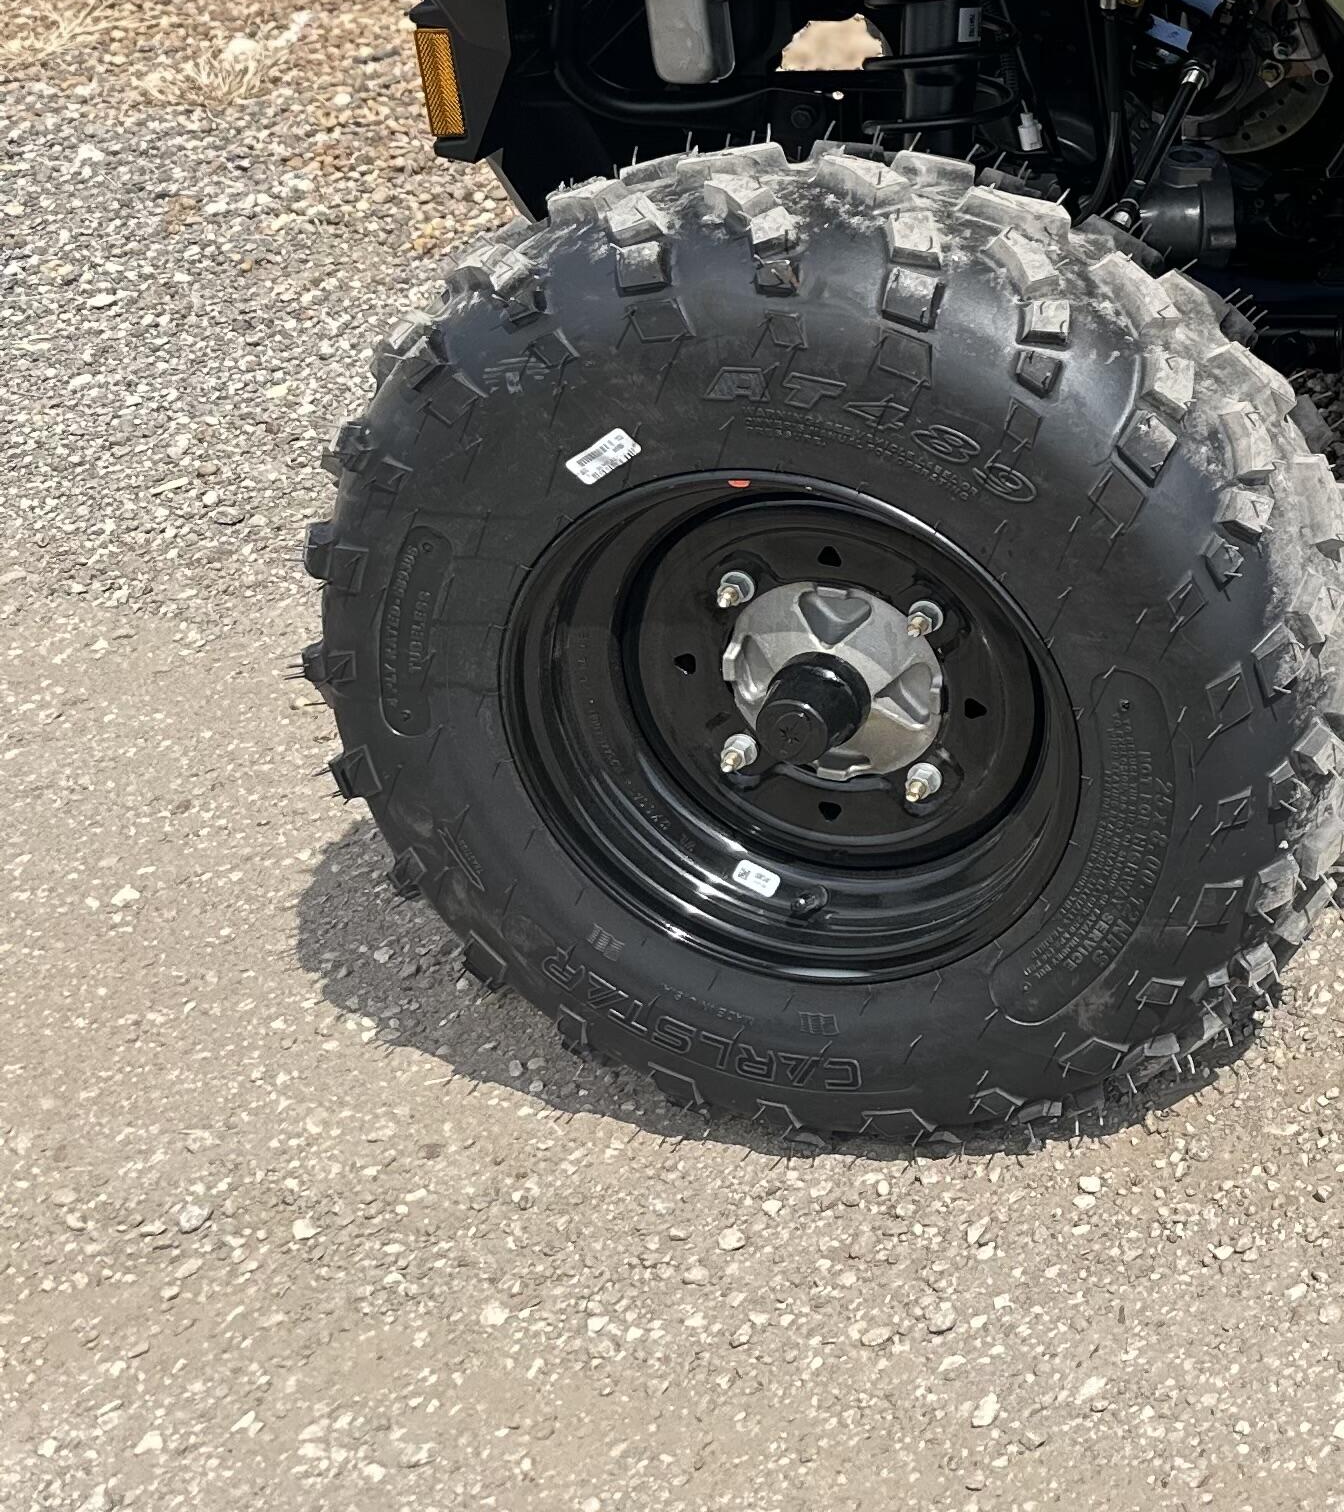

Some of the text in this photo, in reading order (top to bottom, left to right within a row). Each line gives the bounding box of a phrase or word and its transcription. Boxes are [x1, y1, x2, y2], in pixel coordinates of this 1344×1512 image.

[703, 365, 1038, 503] AT489
[1062, 911, 1115, 972] SERVICE
[541, 945, 863, 1090] CARLSTAR
